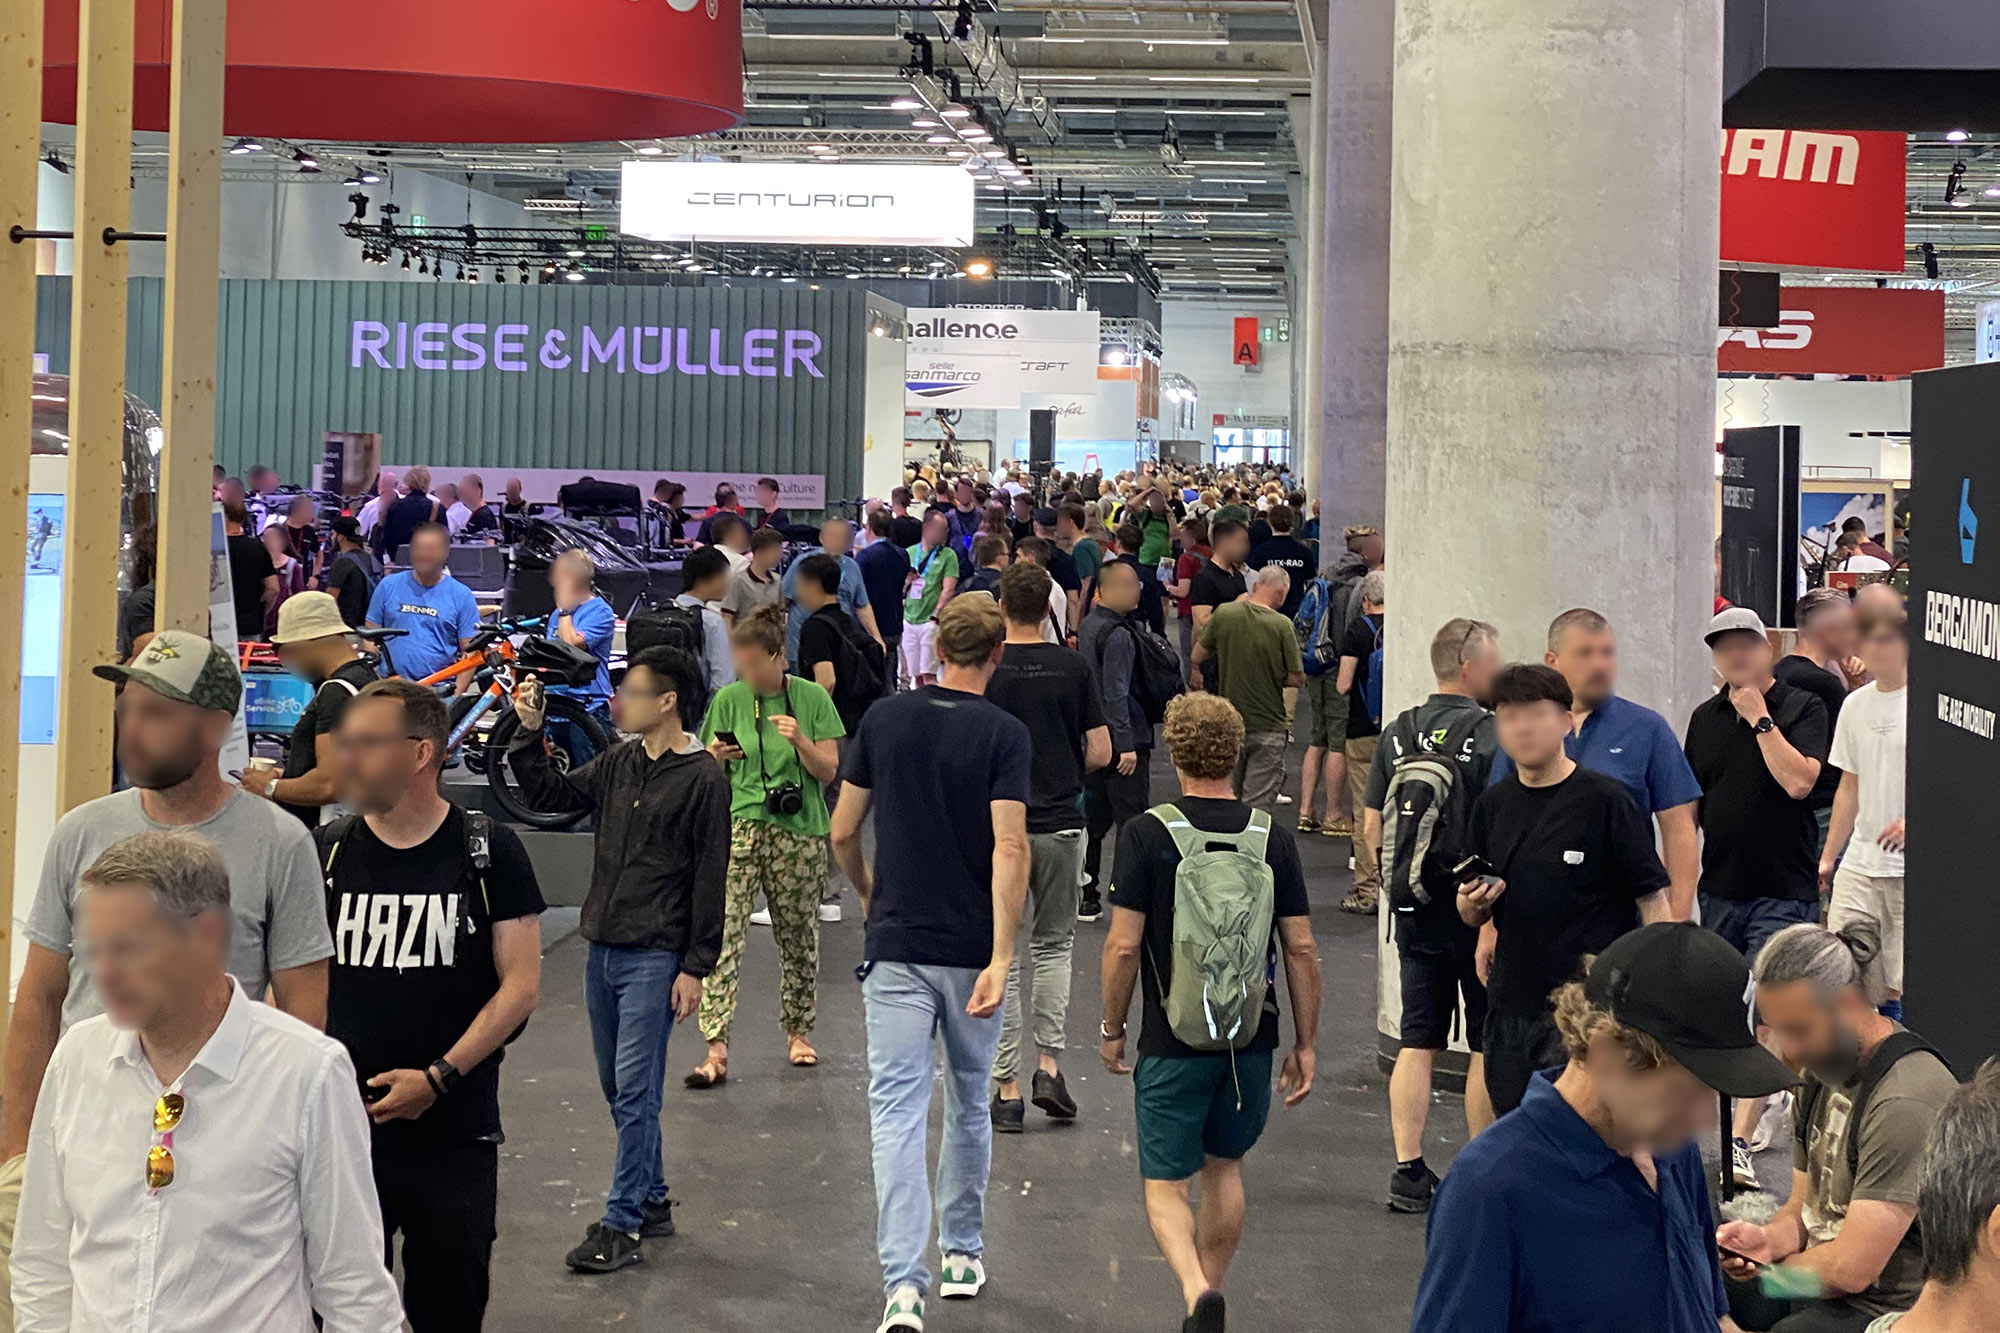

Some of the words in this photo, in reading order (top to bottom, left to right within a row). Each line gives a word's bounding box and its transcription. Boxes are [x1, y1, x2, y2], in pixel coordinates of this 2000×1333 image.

[352, 320, 529, 371] RIESE
[539, 328, 572, 369] &
[581, 325, 825, 378] MÜLLER
[1238, 342, 1253, 361] A
[401, 604, 438, 617] BENNO
[1962, 702, 1996, 740] MOBILITY
